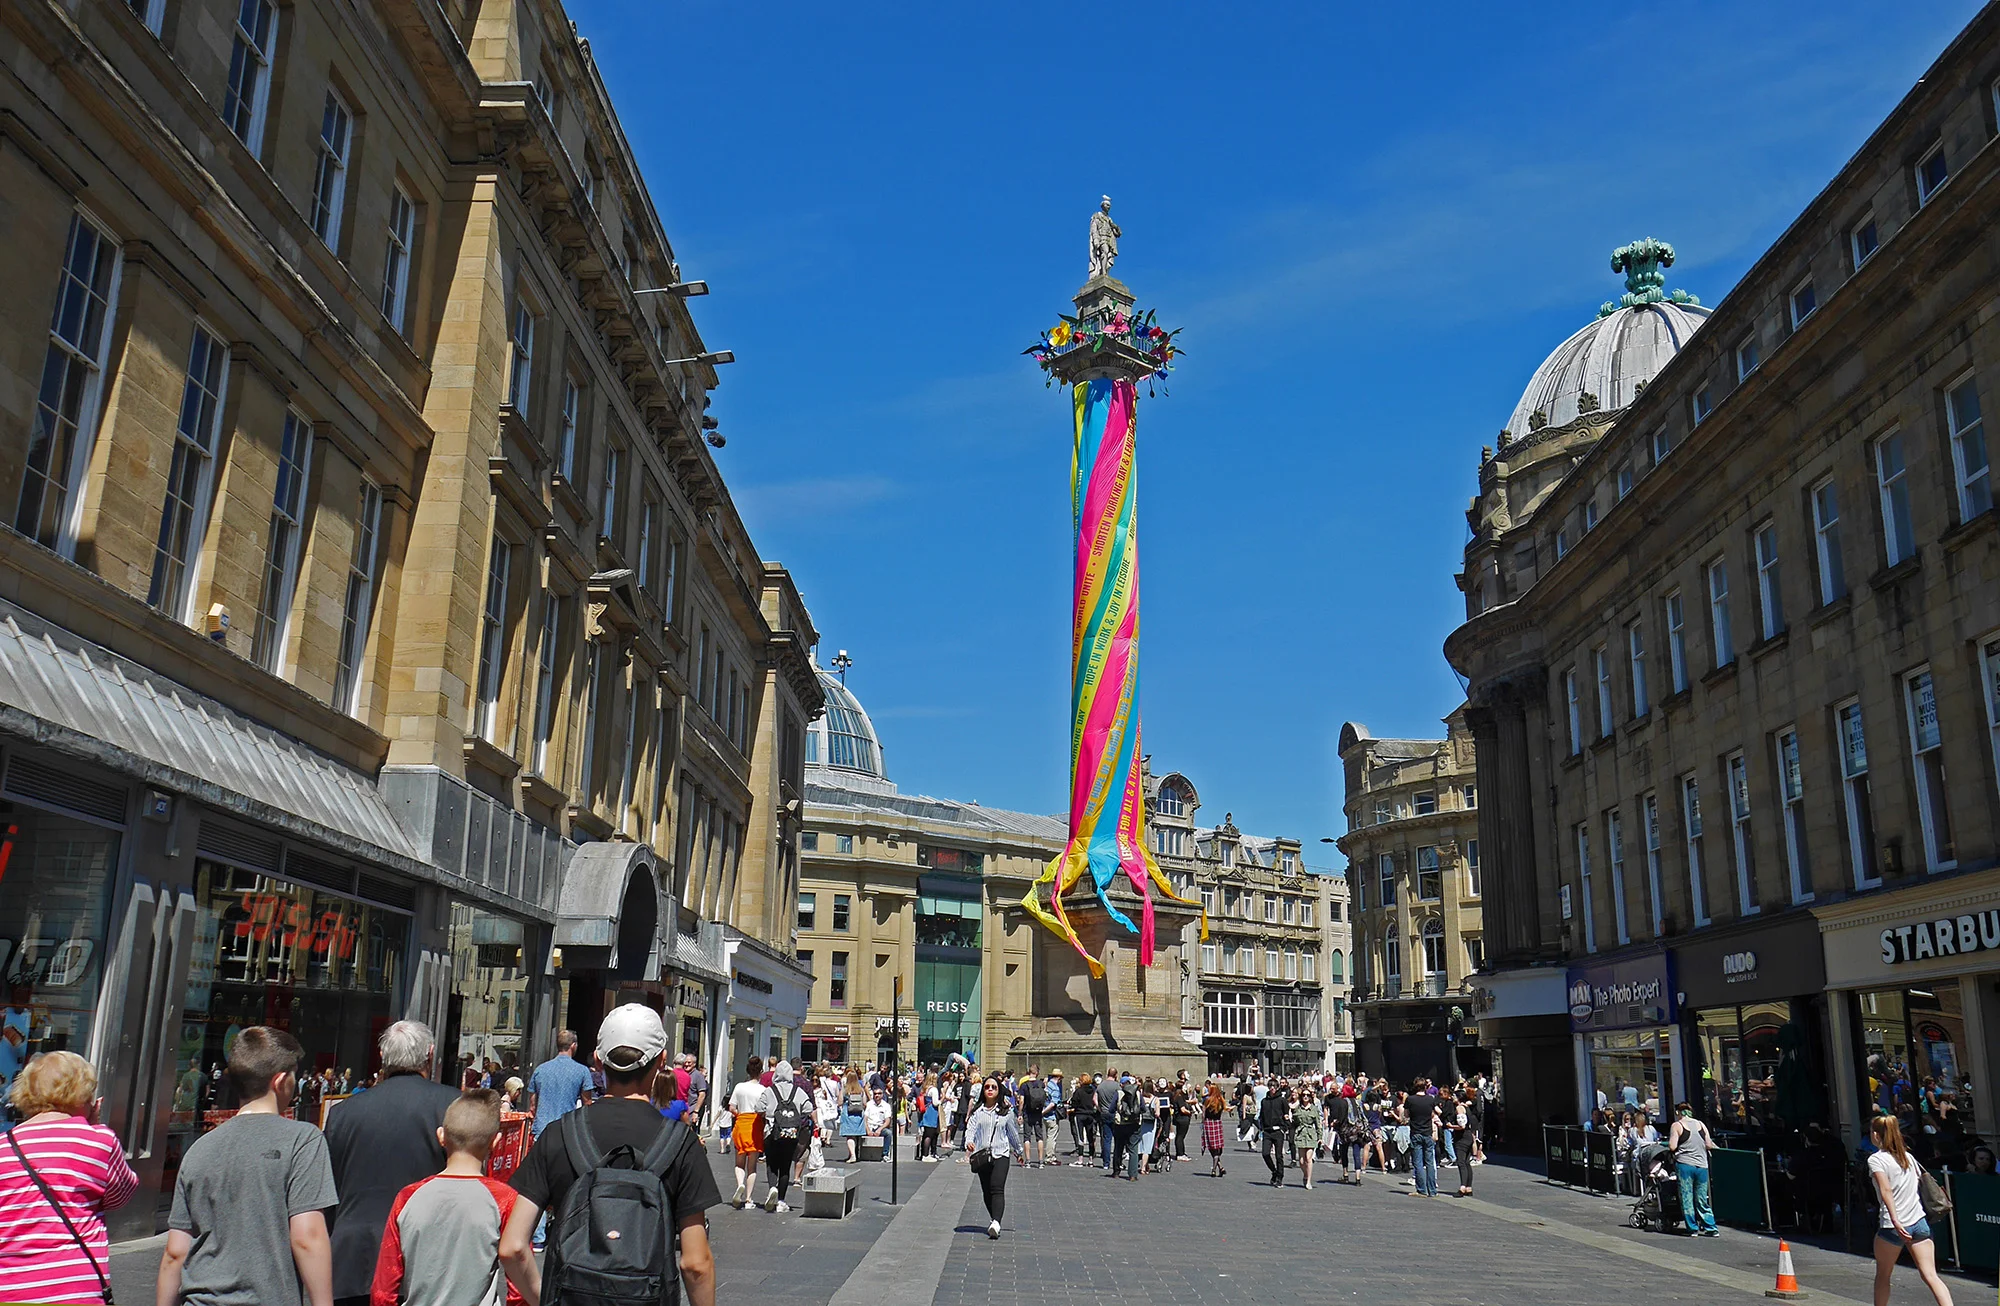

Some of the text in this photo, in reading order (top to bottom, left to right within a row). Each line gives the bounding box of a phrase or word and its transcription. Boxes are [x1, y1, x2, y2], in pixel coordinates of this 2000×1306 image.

[1122, 456, 1130, 466] &
[1117, 464, 1128, 485] DAY
[1104, 484, 1123, 519] WORKING
[1092, 519, 1111, 557] SHORTEN
[1076, 599, 1087, 630] WORLD
[1082, 571, 1096, 597] UNITE
[1085, 558, 1131, 686] HOPE IN WORK & JOY IN LEISURE
[1131, 651, 1138, 663] OF
[1123, 662, 1137, 699] WELFARE
[1118, 702, 1129, 718] THE
[1116, 718, 1125, 729] IS
[1071, 727, 1081, 766] WORKING
[1078, 709, 1086, 726] DAY
[1106, 728, 1122, 762] LABOUR
[1100, 764, 1111, 777] OF
[1130, 761, 1139, 782] LIFE
[1092, 777, 1106, 799] HOPE
[1126, 788, 1135, 797] &
[1129, 779, 1136, 788] A
[1085, 799, 1096, 817] THE
[1123, 795, 1134, 814] ALL
[1120, 813, 1132, 832] FOR
[1880, 910, 2000, 964] STARBU
[1569, 985, 1592, 1006] MAX
[1594, 979, 1660, 1007] The Photo Expert
[926, 1001, 968, 1013] REISS
[875, 1017, 910, 1032] Jame's
[1975, 1213, 2000, 1225] STARBU
